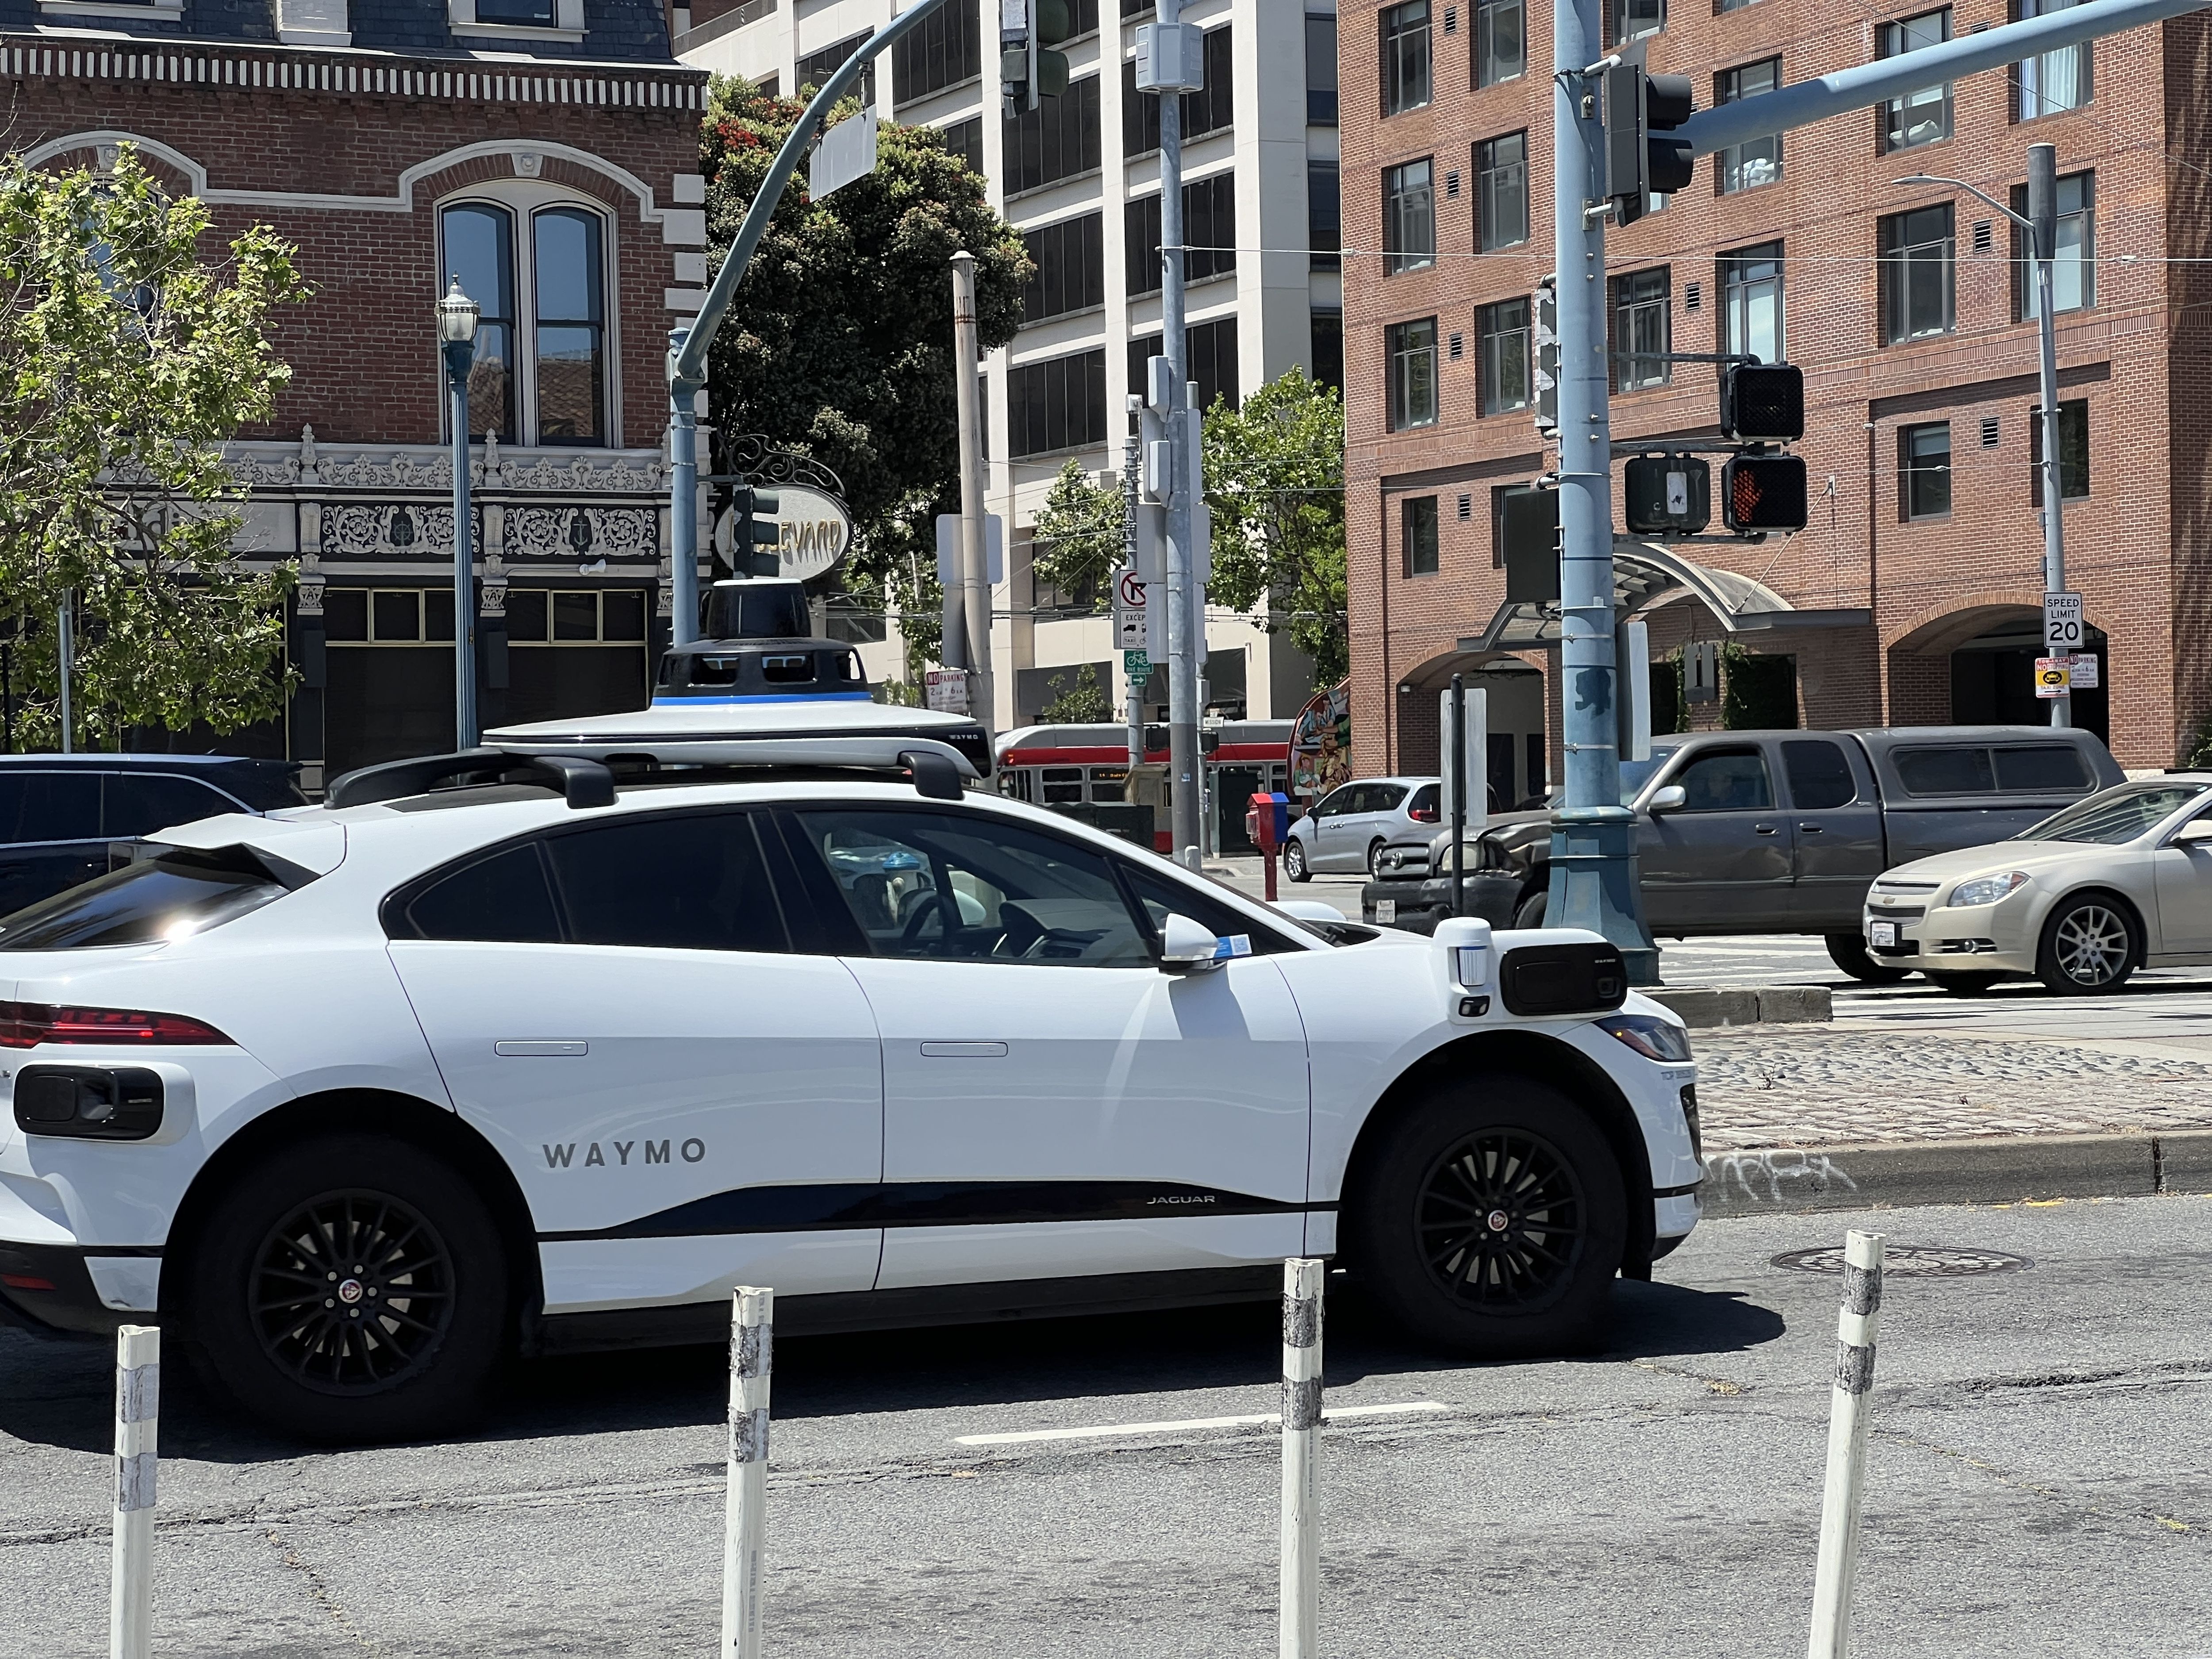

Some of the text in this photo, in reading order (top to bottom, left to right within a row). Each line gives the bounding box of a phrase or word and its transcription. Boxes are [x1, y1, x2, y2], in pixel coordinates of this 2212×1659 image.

[2051, 610, 2076, 618] LIMIT
[2049, 622, 2079, 641] 20
[2070, 655, 2078, 664] NO
[928, 673, 964, 684] NO PARKING
[542, 1138, 706, 1168] WAYMO
[1147, 1195, 1215, 1204] JAGUAR
